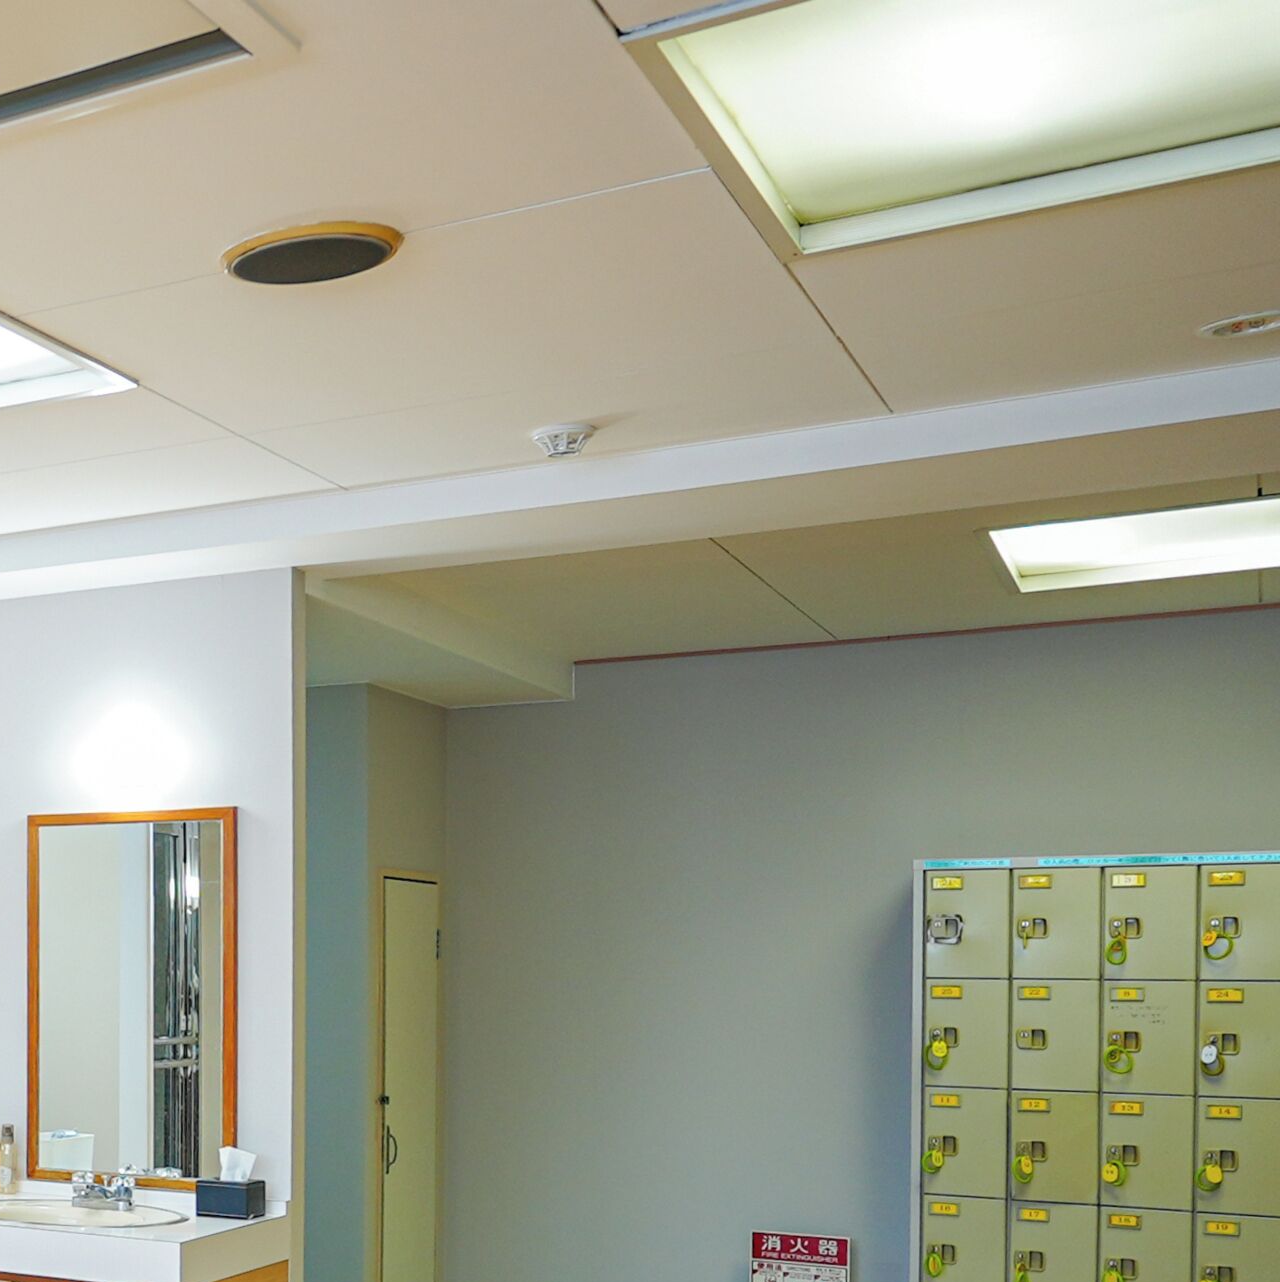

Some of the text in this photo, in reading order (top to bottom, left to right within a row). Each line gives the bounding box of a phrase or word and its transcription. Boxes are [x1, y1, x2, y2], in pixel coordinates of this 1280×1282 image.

[761, 1234, 839, 1257] 消火器
[761, 1250, 839, 1264] FIRE EXTINGUISHER
